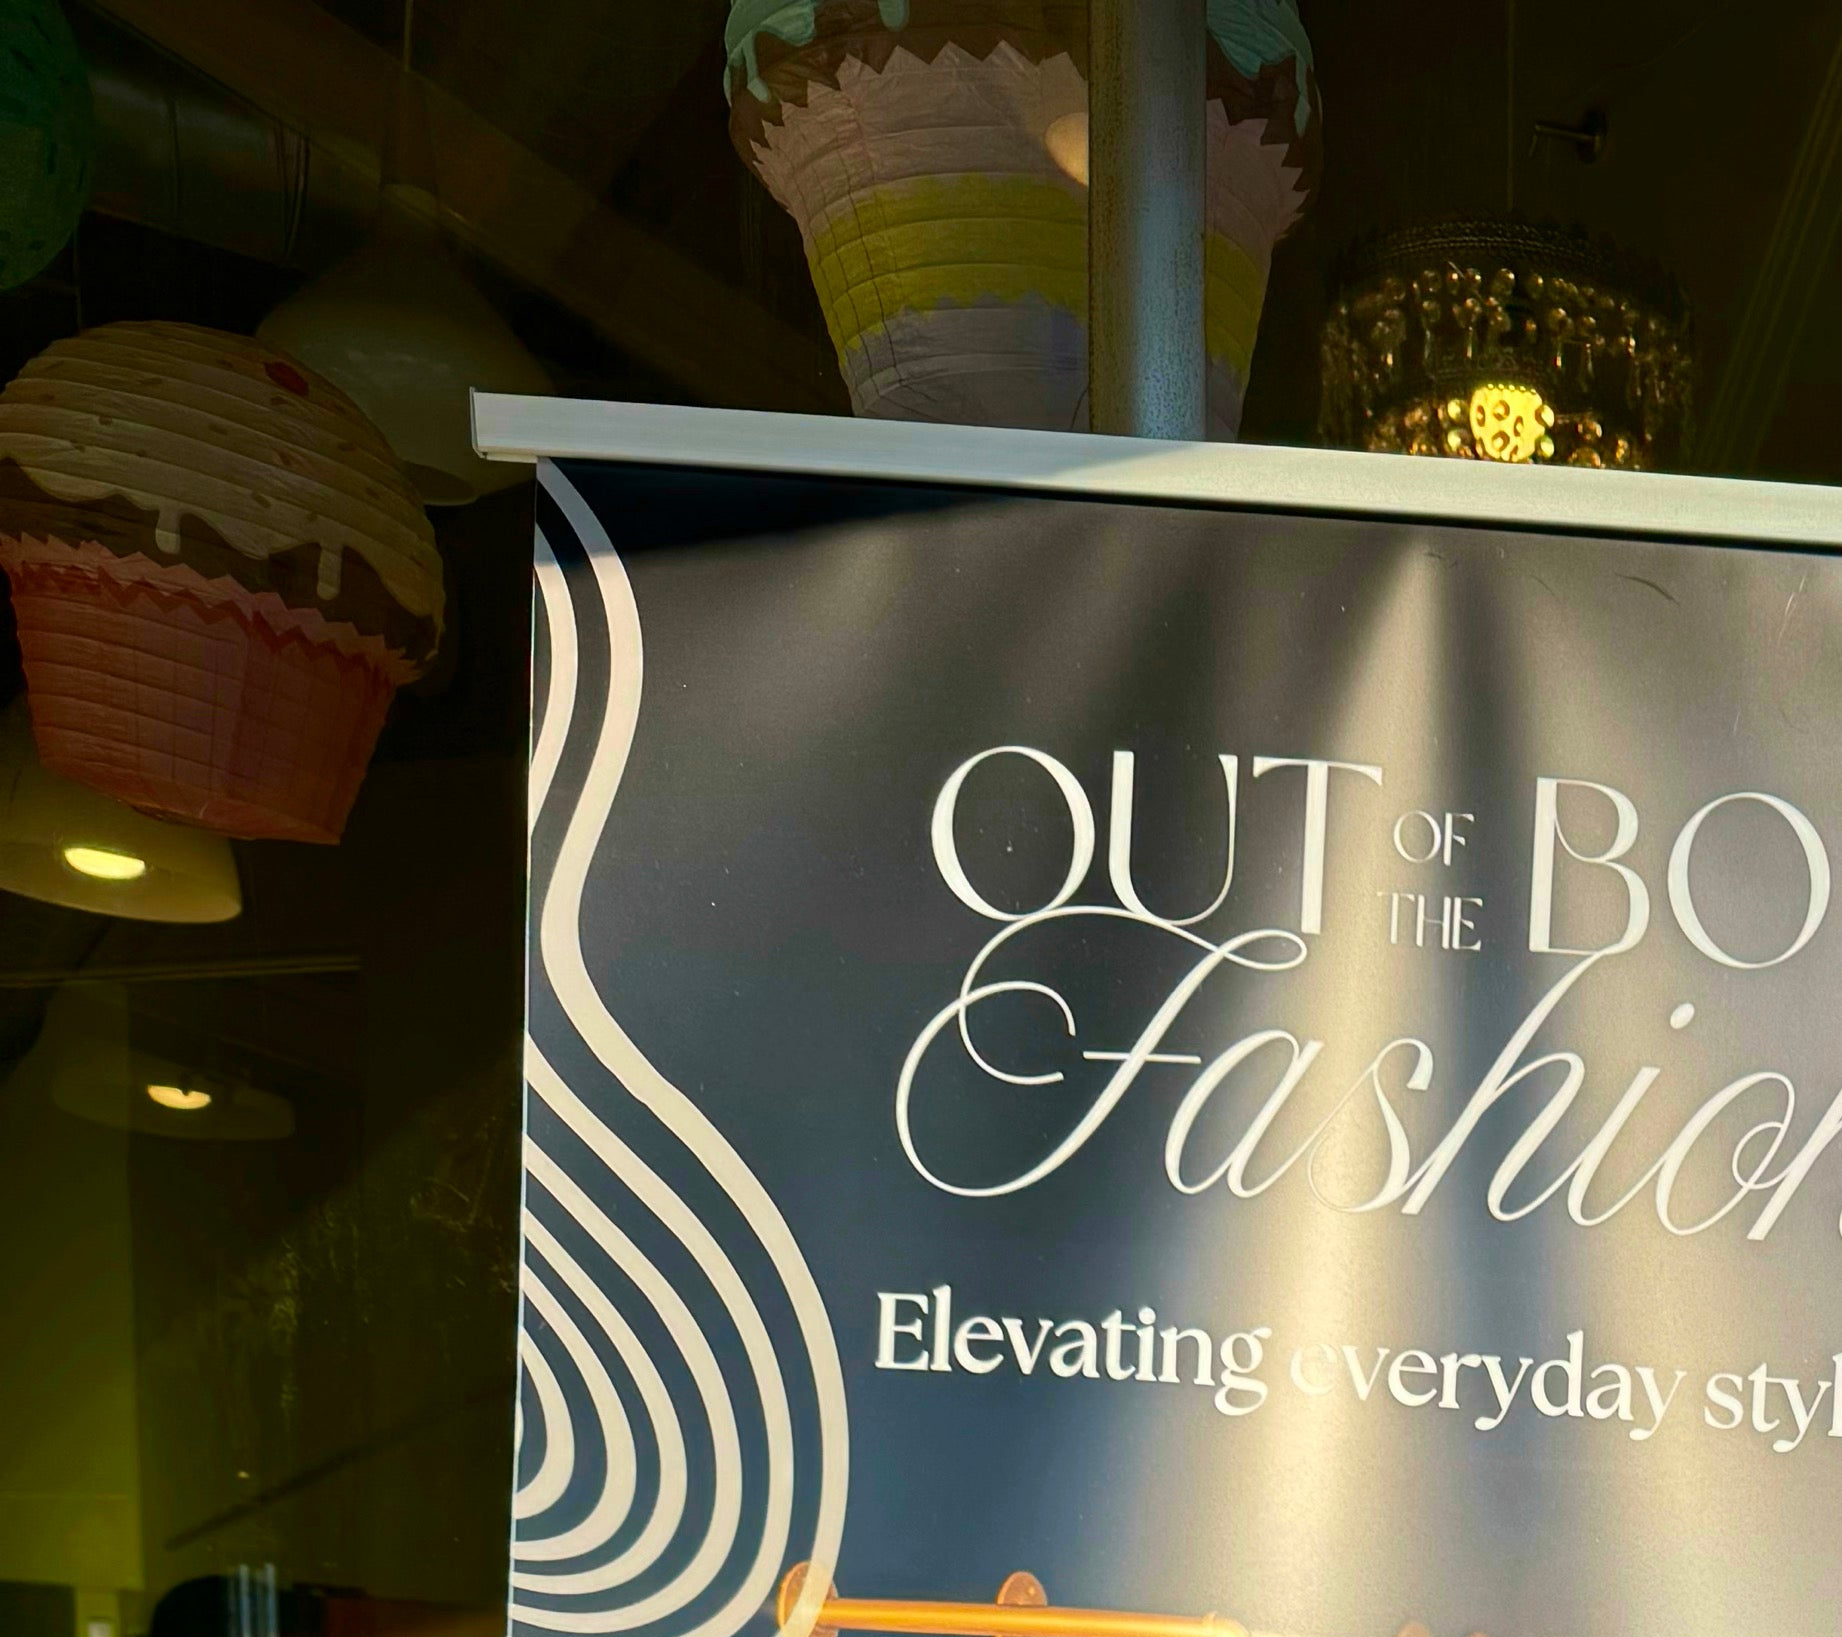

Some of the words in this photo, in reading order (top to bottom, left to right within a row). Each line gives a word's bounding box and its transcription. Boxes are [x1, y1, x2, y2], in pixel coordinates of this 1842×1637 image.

[931, 745, 1383, 935] OUT
[1393, 809, 1475, 867] OF
[1377, 890, 1483, 953] THE
[875, 1284, 1272, 1416] Elevating
[1290, 1331, 1688, 1441] everyday
